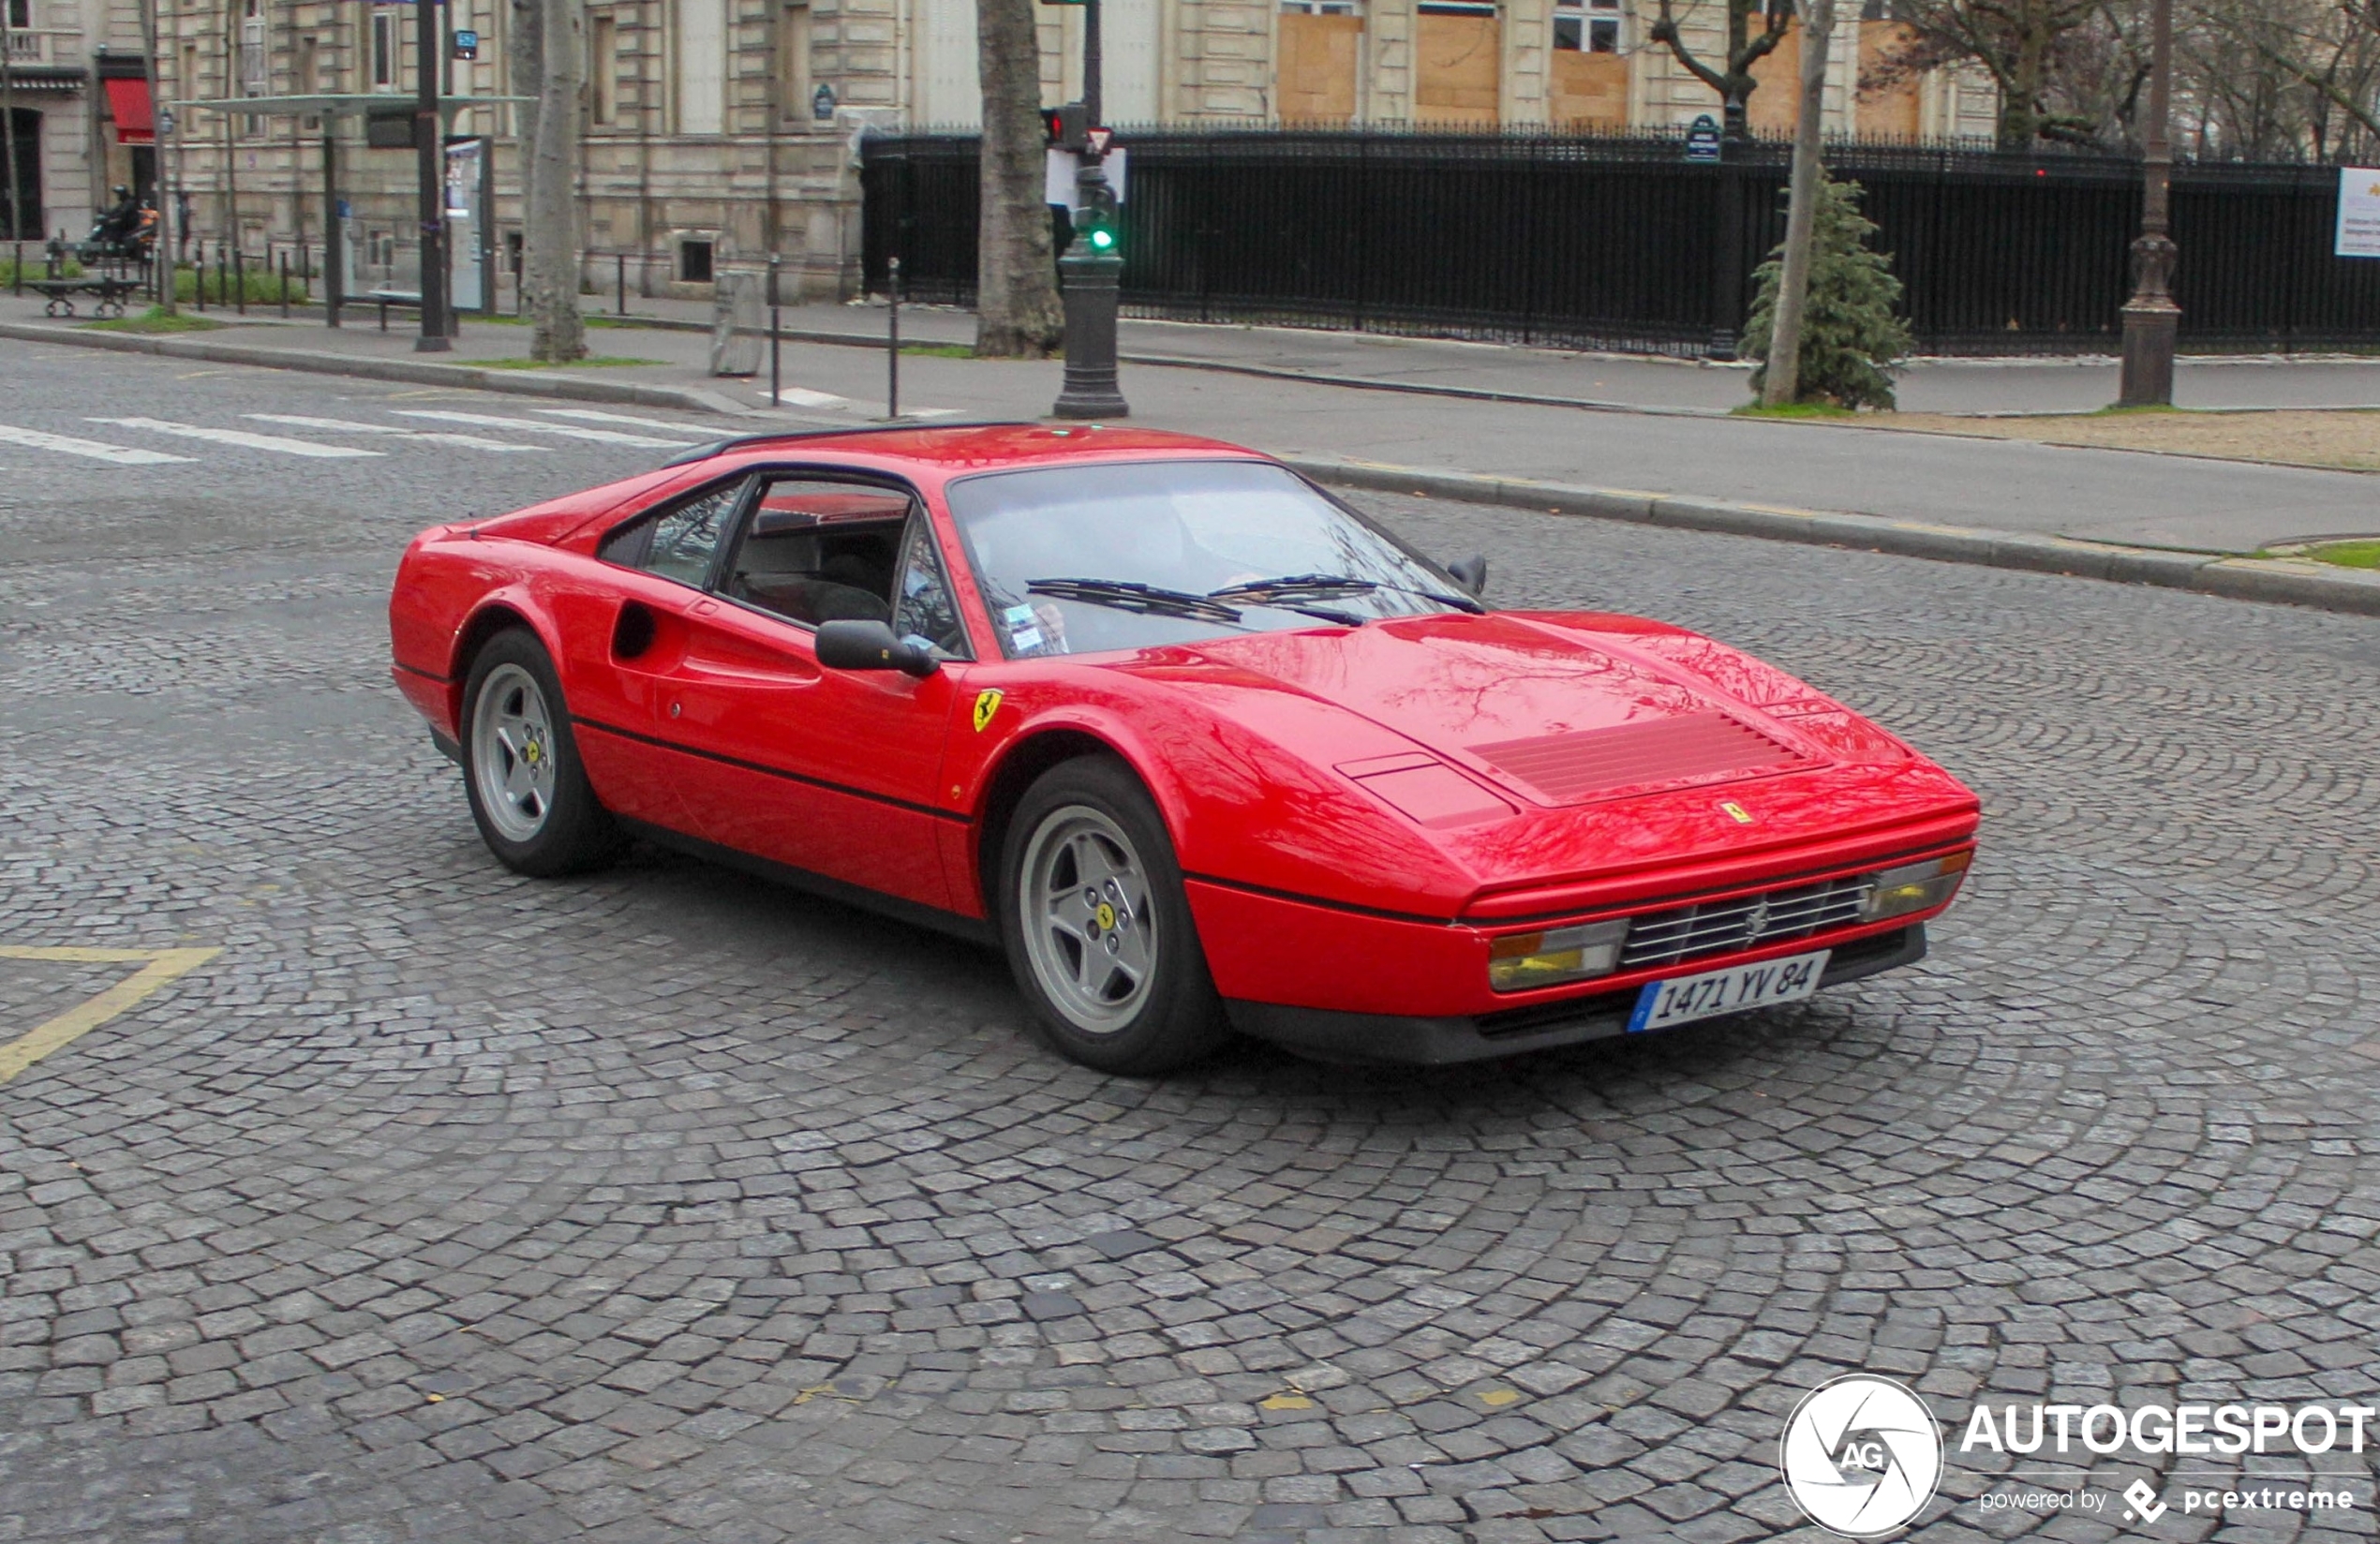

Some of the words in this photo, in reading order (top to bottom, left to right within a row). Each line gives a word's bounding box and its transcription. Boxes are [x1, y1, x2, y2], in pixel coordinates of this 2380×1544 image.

[1657, 975, 1730, 1018] 1471
[1737, 966, 1776, 1002] YV
[1776, 959, 1814, 995] 84
